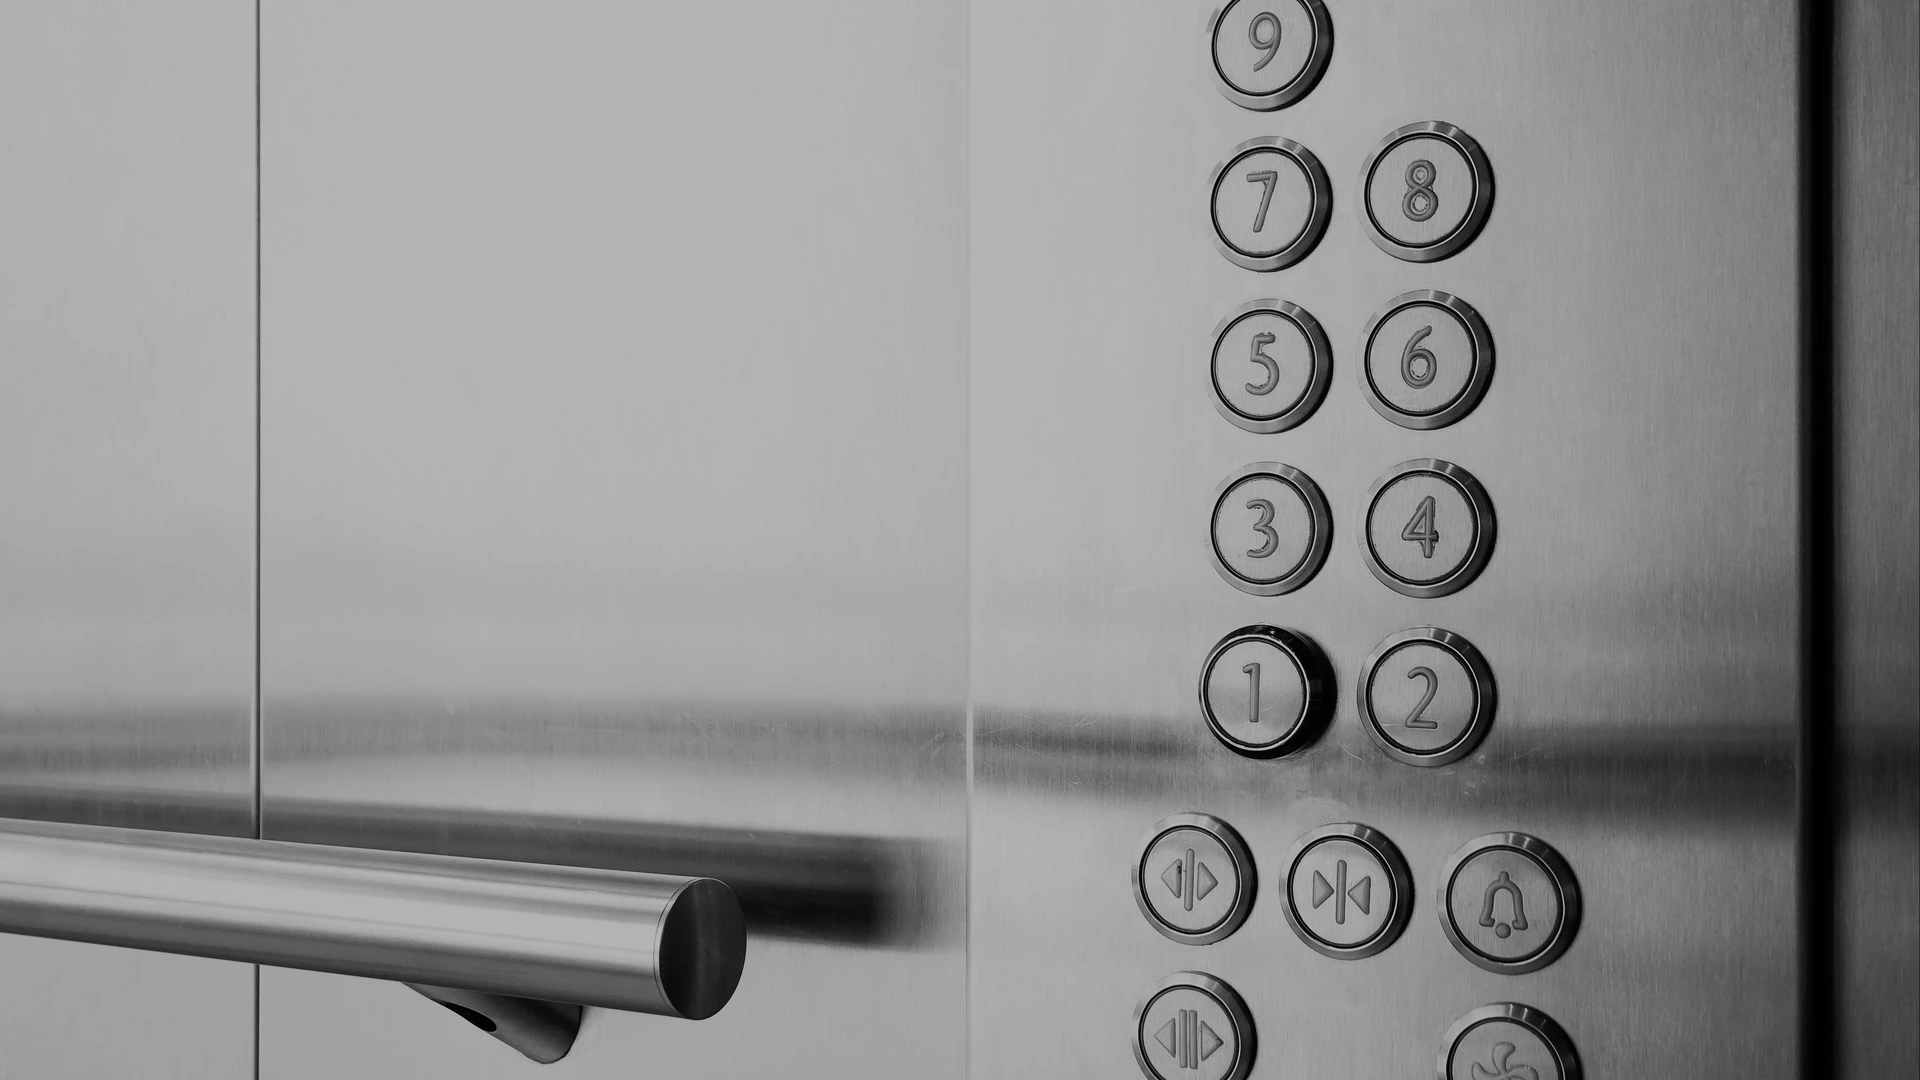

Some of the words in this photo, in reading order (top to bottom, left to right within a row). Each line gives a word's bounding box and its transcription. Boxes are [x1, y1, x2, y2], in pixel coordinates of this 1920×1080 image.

[1249, 11, 1282, 72] 9
[1246, 170, 1278, 233] 7
[1402, 159, 1438, 222] 8
[1245, 332, 1280, 396] 5
[1400, 325, 1437, 389] 6
[1246, 498, 1279, 558] 3
[1401, 495, 1439, 559] 4
[1242, 662, 1260, 723] 1
[1404, 666, 1438, 729] 2
